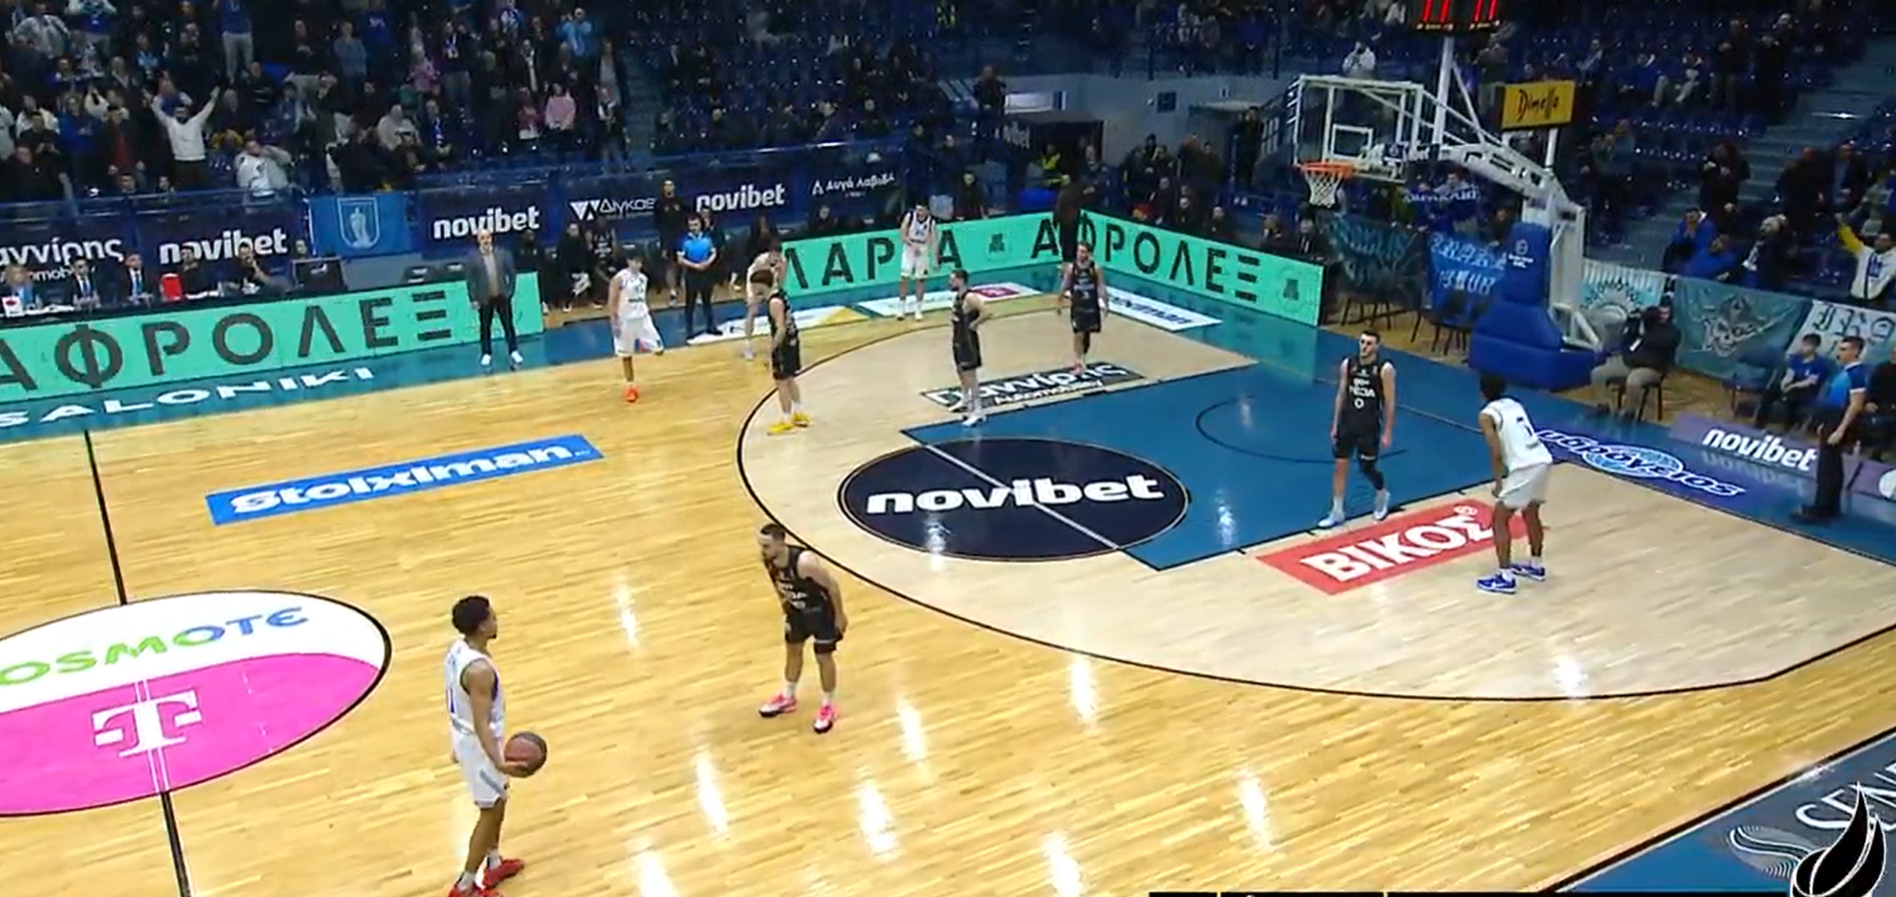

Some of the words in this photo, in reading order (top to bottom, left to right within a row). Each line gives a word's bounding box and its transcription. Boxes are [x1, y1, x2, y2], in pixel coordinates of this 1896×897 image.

[696, 183, 785, 212] novibet
[433, 206, 540, 239] novibet
[160, 227, 288, 264] novibet
[1703, 429, 1818, 471] novibet
[230, 444, 573, 513] Stoiximan
[866, 475, 1165, 514] novibet
